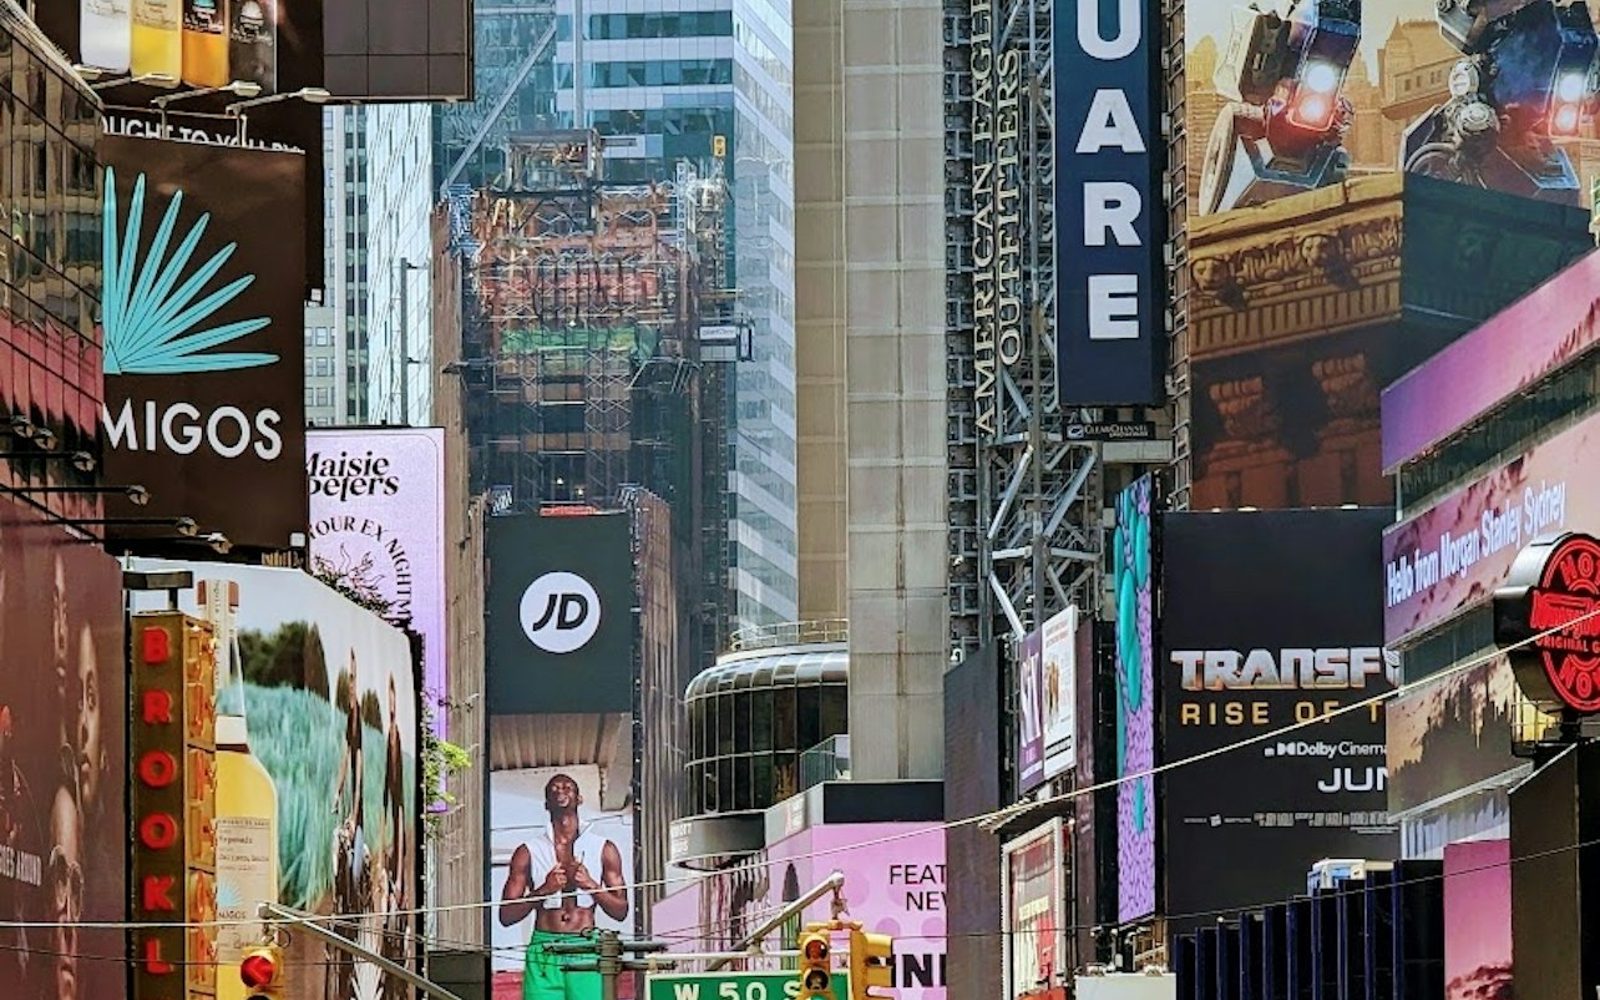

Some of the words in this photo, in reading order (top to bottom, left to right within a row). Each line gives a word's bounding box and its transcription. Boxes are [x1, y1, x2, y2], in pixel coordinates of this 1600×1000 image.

[1075, 0, 1147, 340] UARE
[997, 48, 1022, 366] OUTFITTERS
[973, 163, 996, 435] AMERICAN
[102, 397, 282, 461] MIGOS
[1387, 555, 1414, 608] Hello
[1414, 548, 1439, 593] from
[1440, 531, 1480, 579] Morgan
[1482, 499, 1522, 549] Stanley
[1524, 480, 1566, 537] Sydney
[1560, 552, 1600, 587] HO
[532, 593, 589, 632] JD
[1181, 701, 1270, 725] RISE
[1294, 701, 1341, 724] OF
[1297, 741, 1338, 759] Dolby
[138, 625, 177, 975] BROOKL
[890, 864, 947, 885] FEAT
[673, 983, 699, 1000] W
[718, 981, 767, 1000] 50
[783, 980, 801, 1000] S
